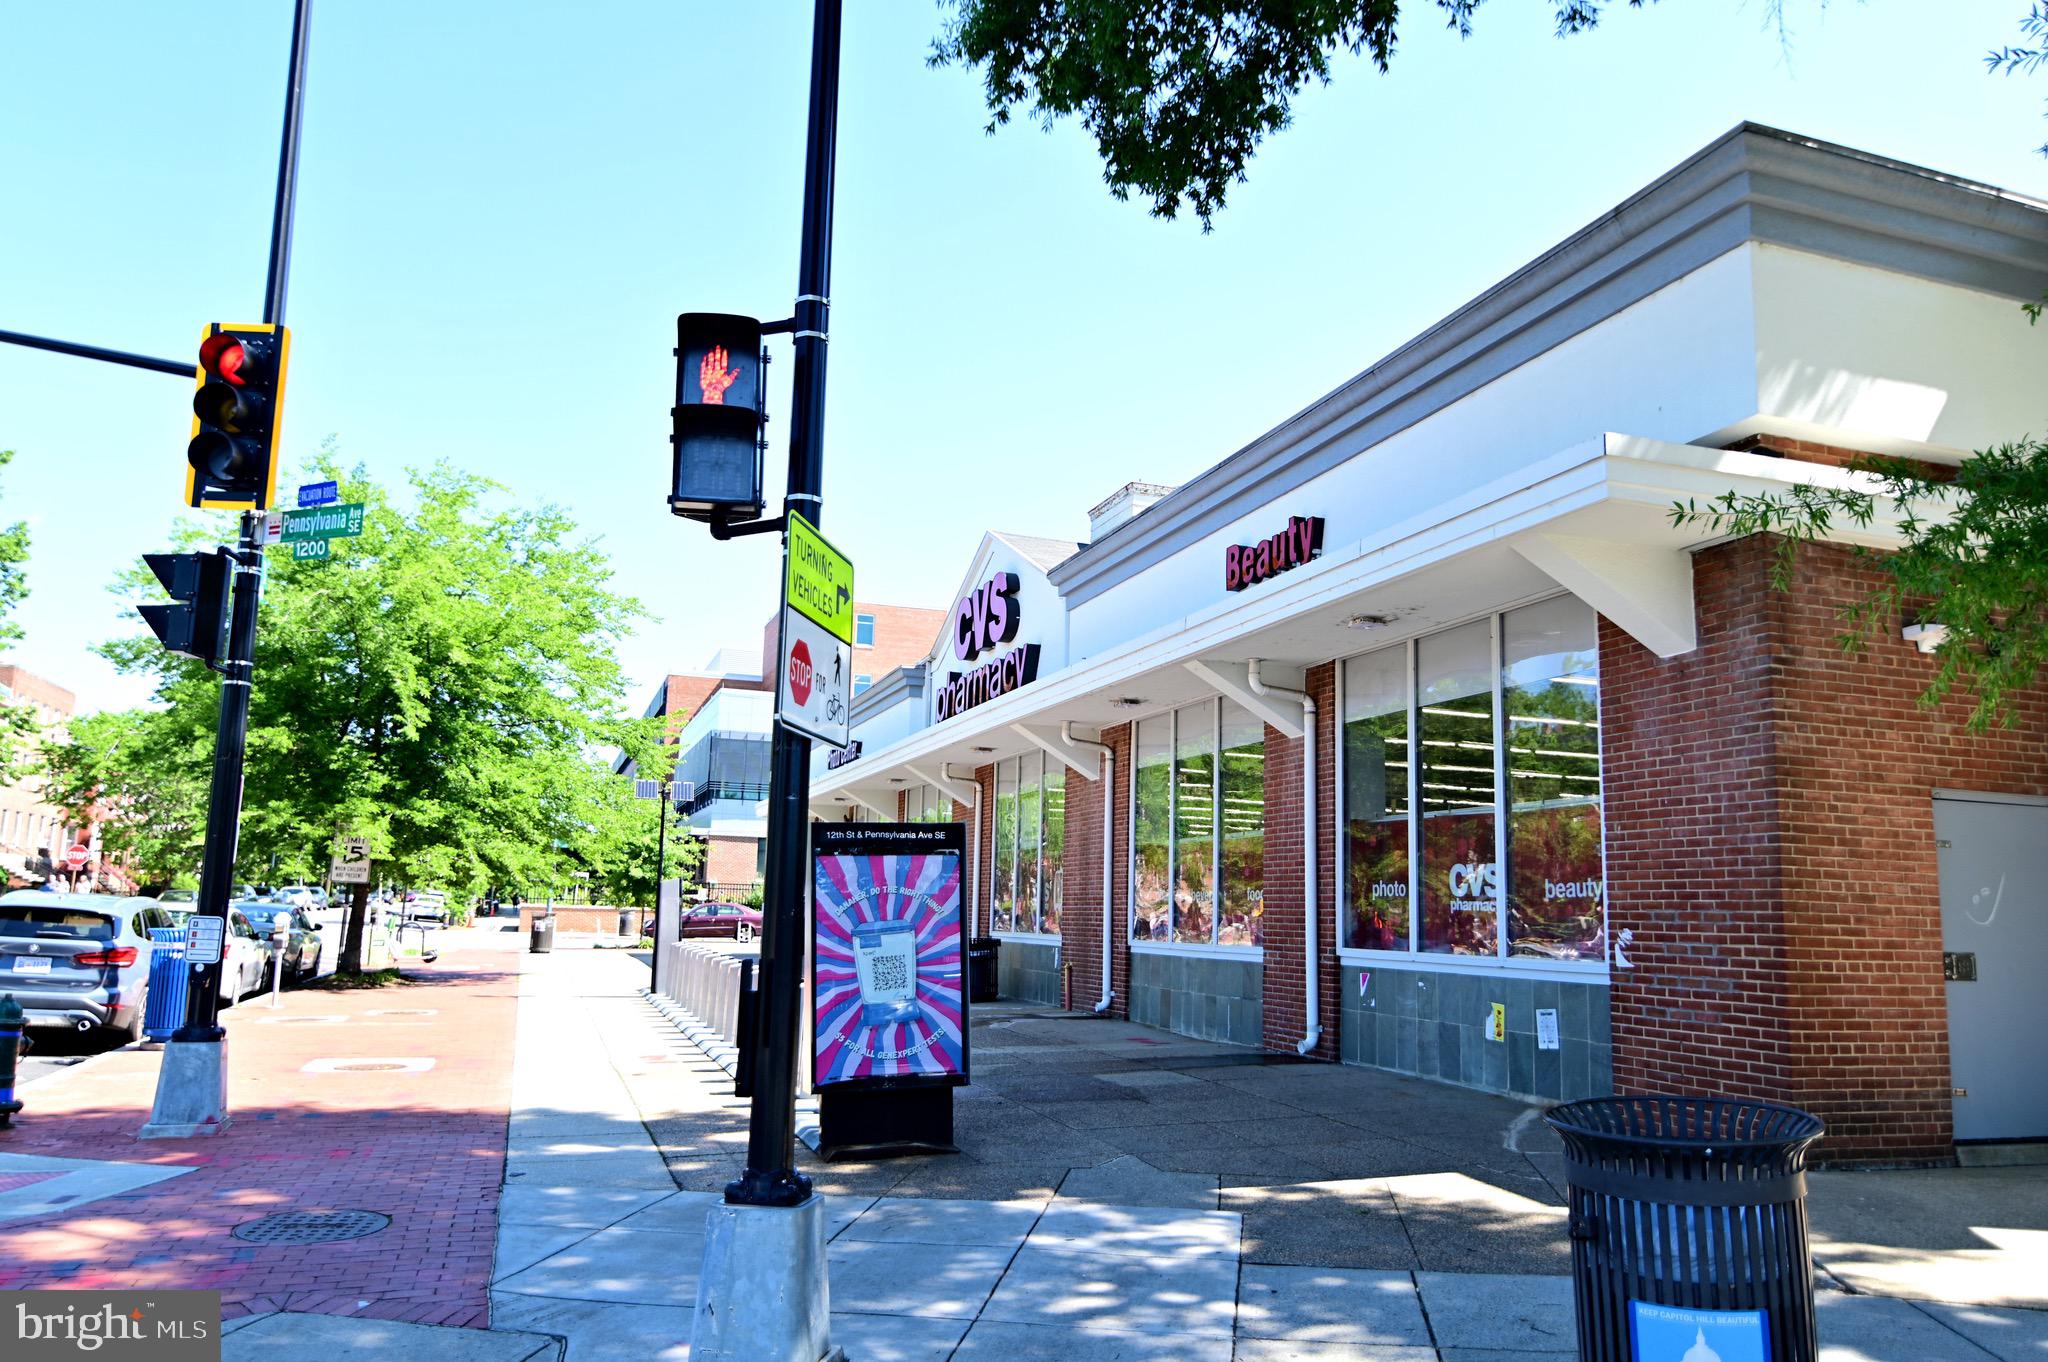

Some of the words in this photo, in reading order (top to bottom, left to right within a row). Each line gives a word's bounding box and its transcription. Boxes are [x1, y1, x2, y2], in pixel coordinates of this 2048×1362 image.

[283, 510, 346, 535] Pennsylvania
[349, 507, 361, 520] Ave
[348, 520, 361, 533] SE
[296, 540, 326, 557] 1200
[795, 534, 834, 583] TURNING
[1226, 516, 1320, 591] Beauty
[792, 569, 834, 619] VEHICLES
[954, 571, 1016, 661] CVS
[790, 655, 813, 689] STOP
[815, 672, 827, 694] FOR
[935, 643, 1036, 723] pharmacy
[826, 831, 844, 840] 12th
[846, 831, 856, 840] St
[857, 831, 864, 839] &
[865, 831, 916, 840] Pennsylvania
[917, 831, 933, 840] Ave
[934, 831, 946, 840] SE
[67, 851, 89, 860] STOP
[1372, 880, 1406, 901] photo
[1449, 863, 1497, 898] CVS
[1544, 877, 1604, 904] beauty
[870, 887, 880, 896] DO
[882, 886, 897, 895] THE
[899, 887, 921, 900] RIGHT
[1450, 898, 1497, 913] pharmac
[844, 1040, 861, 1054] FOR
[861, 1048, 875, 1058] ALL
[1639, 1308, 1660, 1317] KEEP
[1660, 1311, 1694, 1321] CAPITOL
[1696, 1314, 1715, 1323] HILL
[1716, 1315, 1760, 1325] BEAUTIFUL
